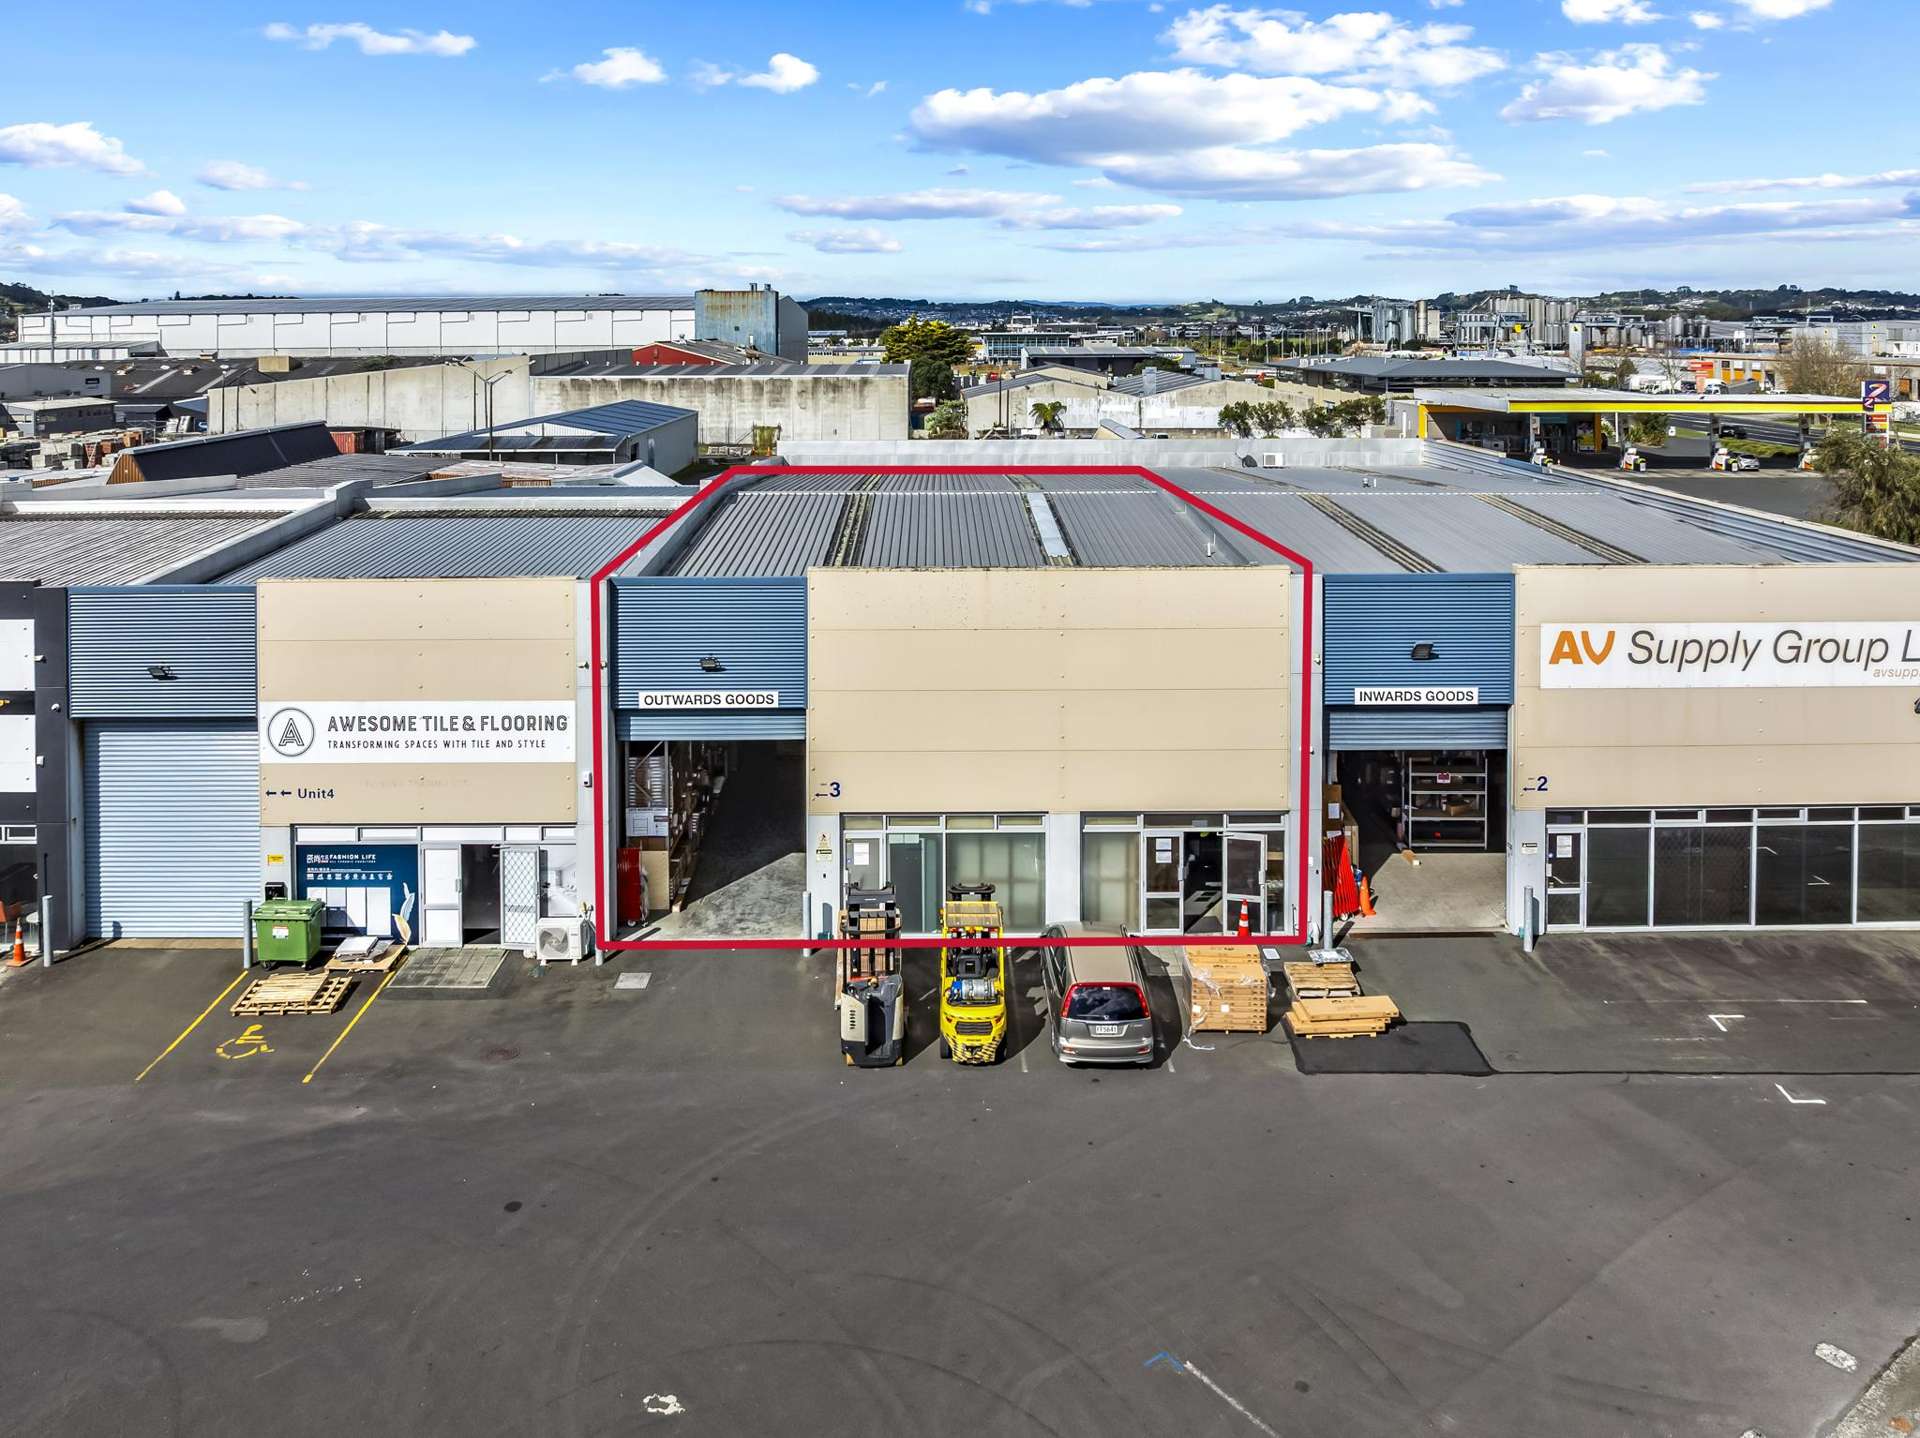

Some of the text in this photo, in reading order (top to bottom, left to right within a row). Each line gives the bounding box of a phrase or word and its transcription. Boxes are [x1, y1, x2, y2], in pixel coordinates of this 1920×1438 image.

[1549, 630, 1616, 665] AV
[1627, 630, 1762, 672] Supply
[1773, 629, 1889, 672] Group
[1873, 668, 1920, 680] avsupp
[644, 693, 775, 706] OUTWARDS GOODS
[1359, 690, 1474, 702] INWARDS GOODS
[327, 715, 568, 732] AWESOME TILE & FLOORING
[328, 739, 546, 749] TRANSFORMING SPACES WITH TILE AND STYLE
[829, 782, 841, 797] 3
[1537, 776, 1548, 791] 2
[297, 788, 335, 799] Unit4
